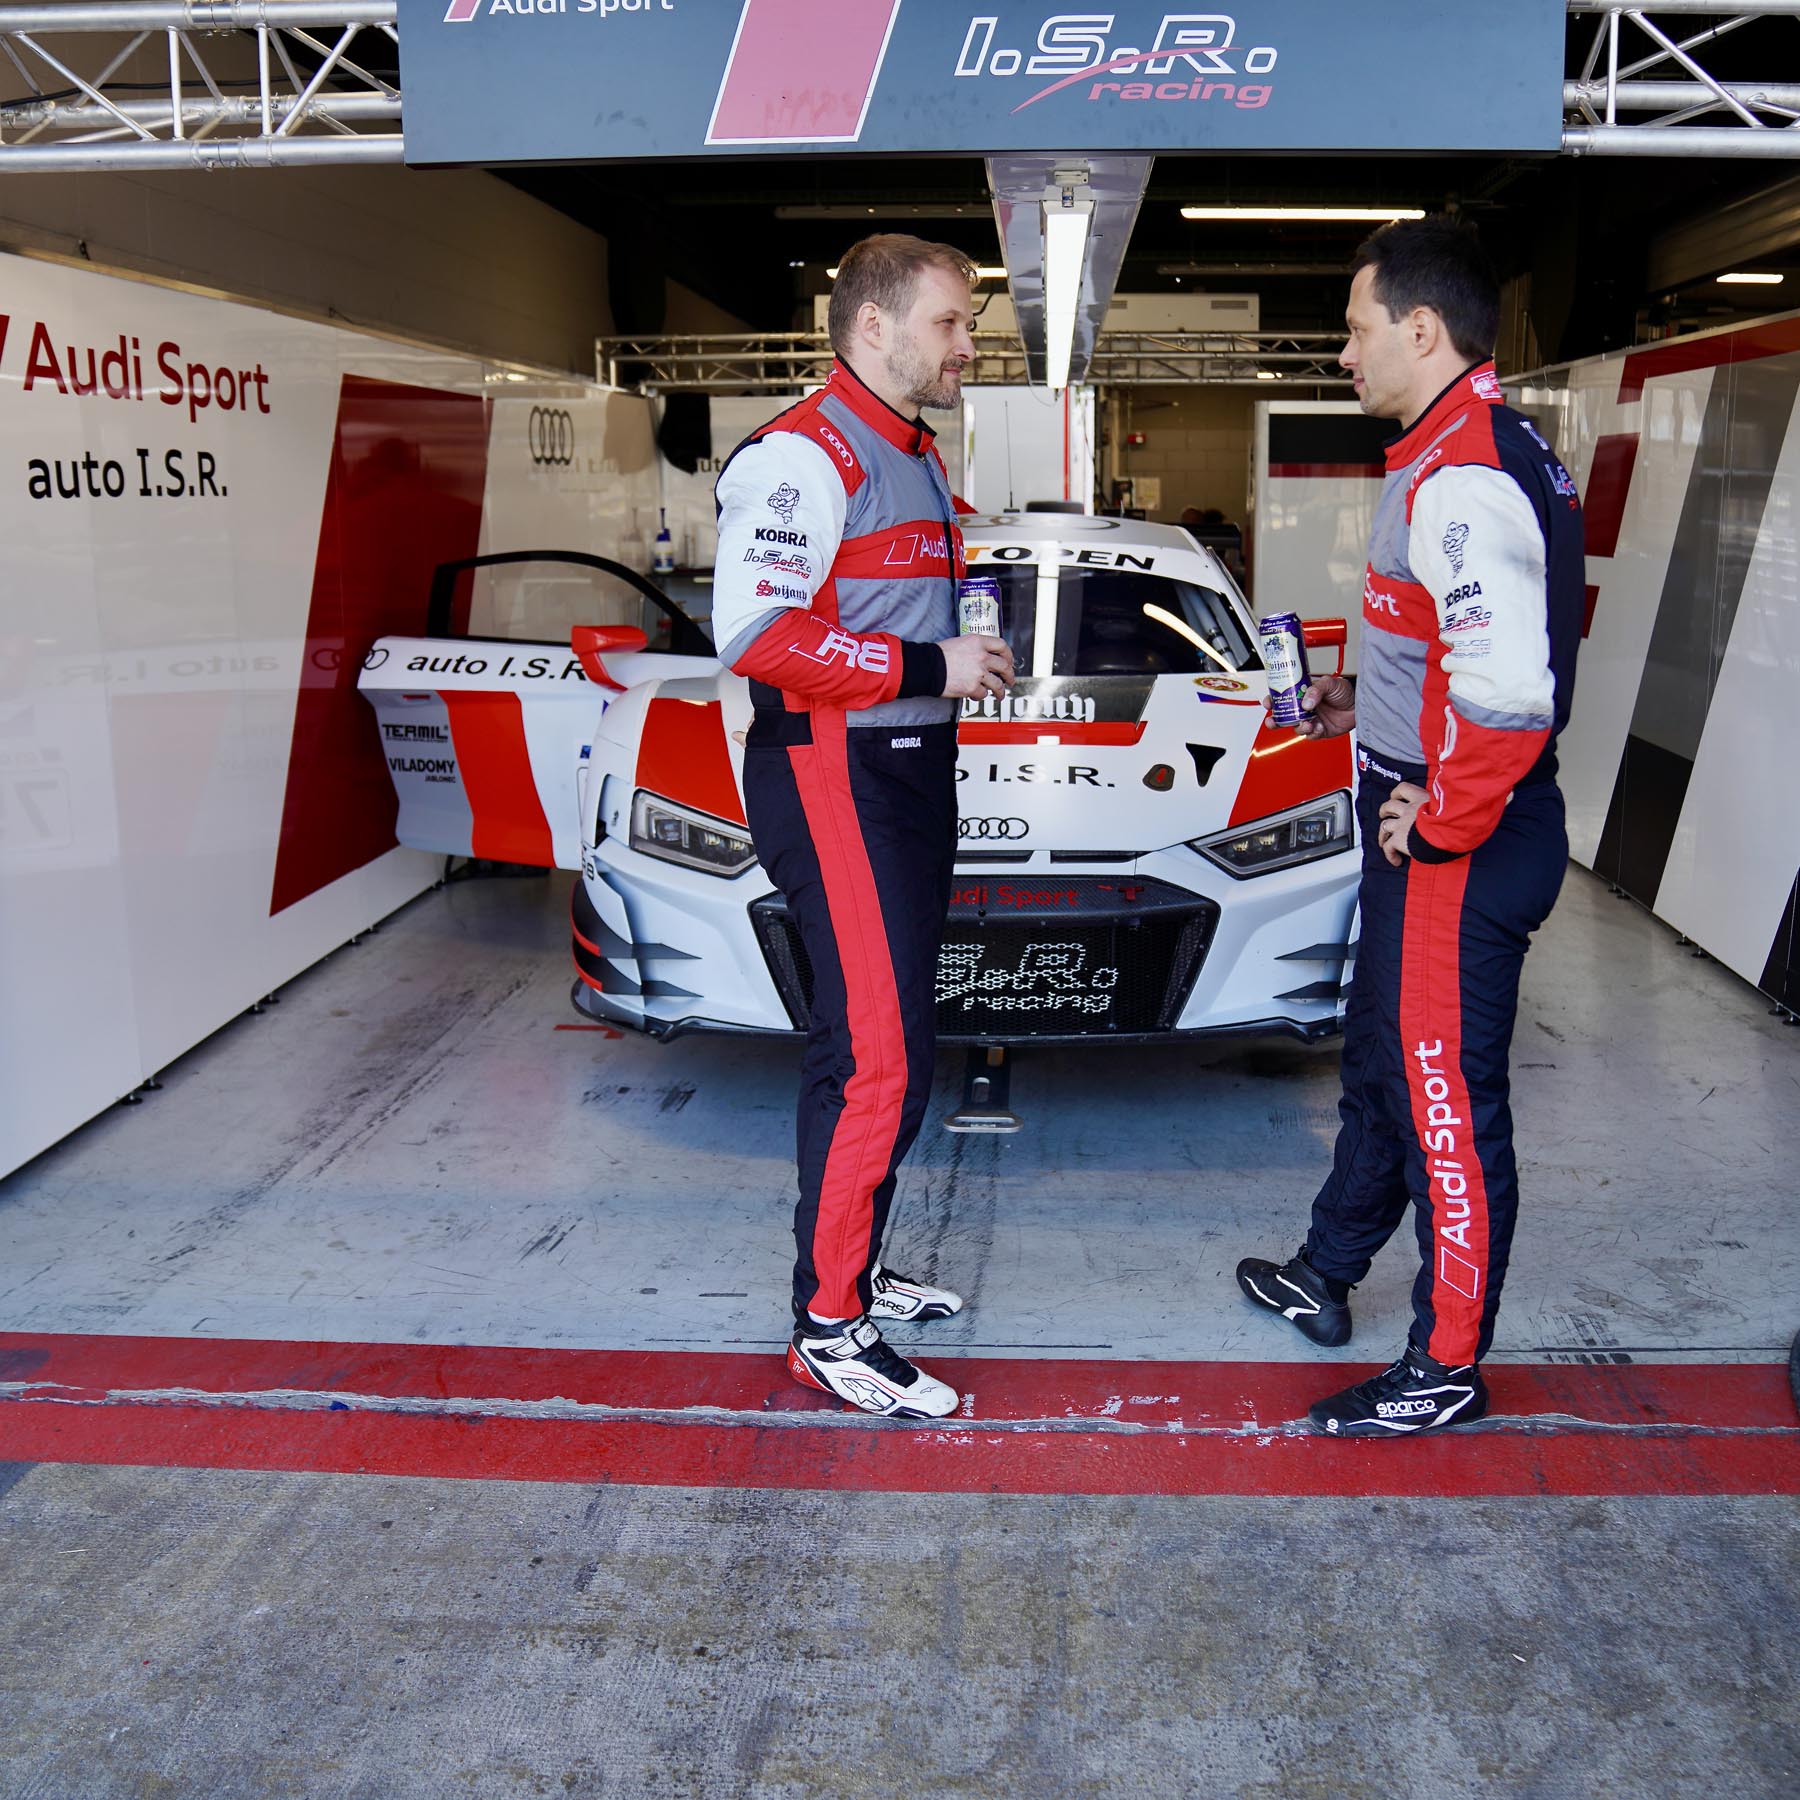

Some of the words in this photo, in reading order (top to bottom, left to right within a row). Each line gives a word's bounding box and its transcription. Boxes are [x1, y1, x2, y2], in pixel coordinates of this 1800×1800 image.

[1088, 77, 1273, 109] racing
[23, 321, 143, 401] Audi
[157, 341, 270, 423] Sport
[28, 451, 125, 499] auto
[136, 448, 228, 497] I.S.R.
[755, 528, 808, 548] KOBRA
[920, 533, 949, 560] Audi
[964, 546, 991, 561] T
[992, 547, 1155, 571] OPEN
[773, 564, 811, 580] racing
[755, 579, 808, 604] Svijany
[815, 630, 889, 674] R8
[407, 655, 488, 675] auto
[962, 685, 1096, 723] vijany
[891, 737, 921, 749] KOBRA
[389, 757, 455, 774] VILADOMY
[950, 885, 988, 905] udi
[997, 886, 1080, 910] Sport
[1414, 1039, 1462, 1153] Sport
[1432, 1158, 1472, 1250] Audi
[872, 1295, 906, 1316] TARS
[1376, 1399, 1438, 1418] sparco
